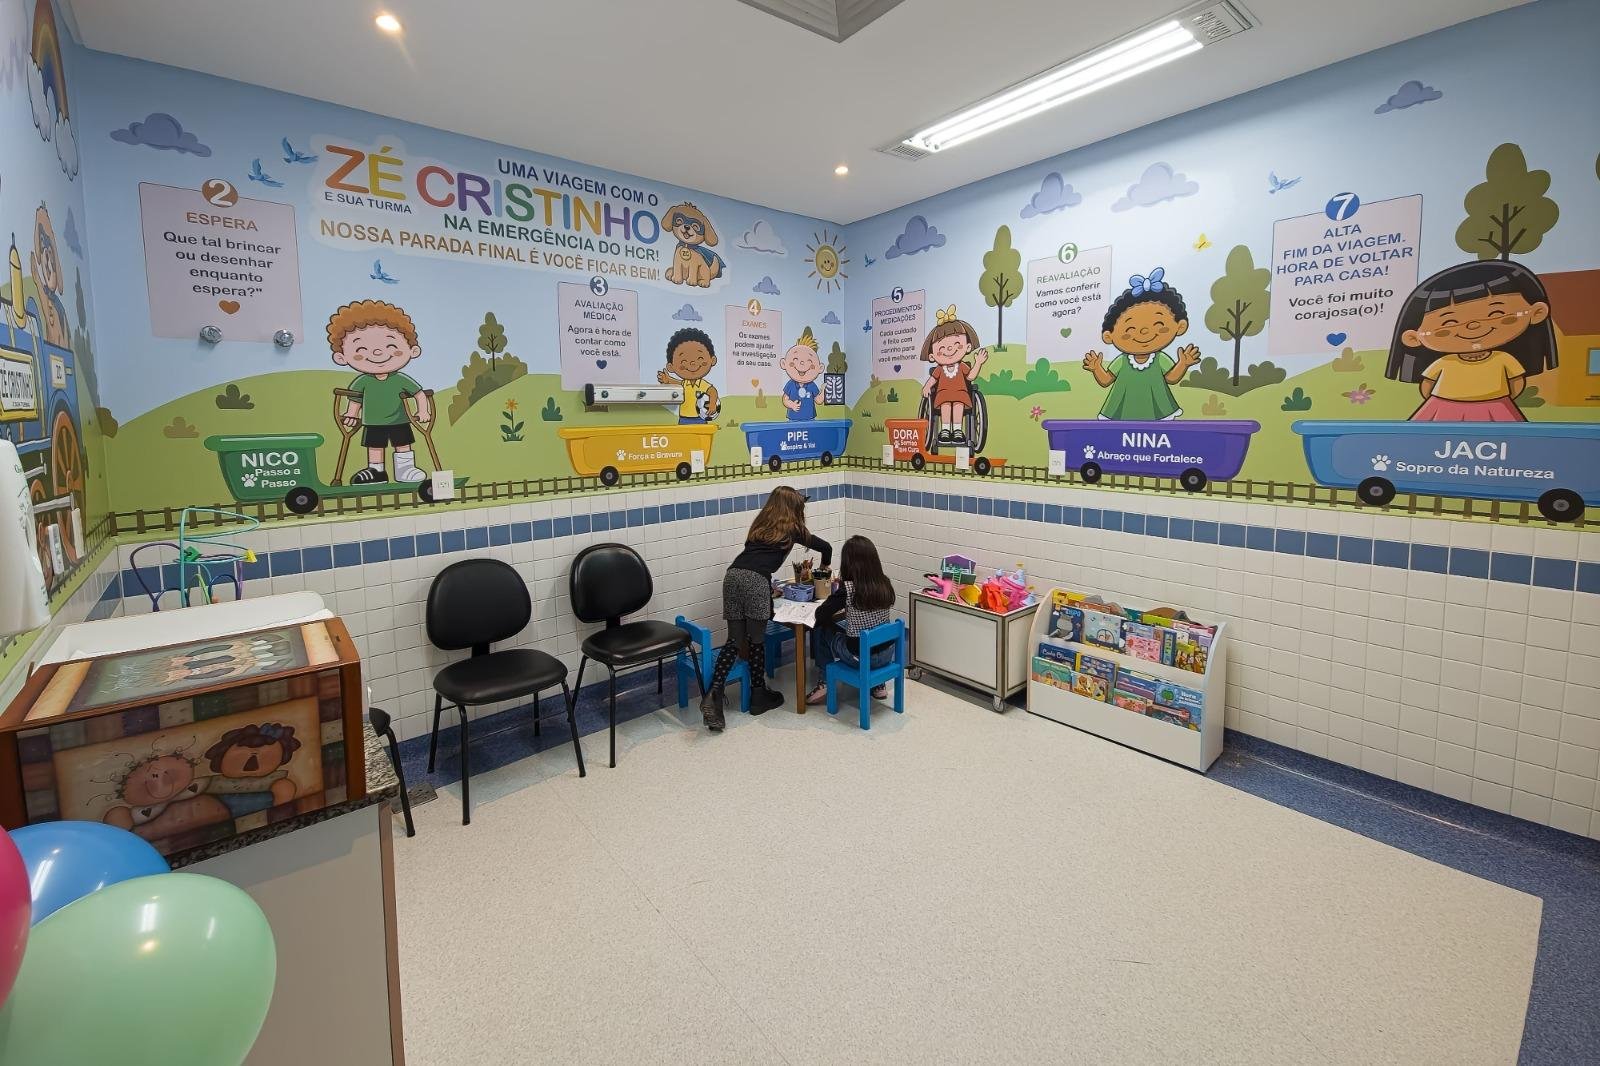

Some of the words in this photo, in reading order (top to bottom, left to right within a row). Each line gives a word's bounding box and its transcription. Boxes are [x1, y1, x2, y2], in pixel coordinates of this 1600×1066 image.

[498, 158, 539, 182] UMA
[543, 169, 606, 196] VIAGEM
[611, 185, 644, 204] COM
[648, 193, 658, 206] O
[209, 179, 233, 207] 2
[325, 145, 406, 200] ZÉ
[416, 166, 660, 244] CRISTINHO
[325, 192, 333, 201] E
[337, 193, 364, 206] SUA
[367, 198, 412, 214] TURMA
[1333, 193, 1354, 221] 7
[186, 211, 258, 231] ESPERA
[444, 213, 472, 232] NA
[478, 219, 594, 251] EMERGÊNCIA
[599, 240, 621, 255] DO
[625, 244, 659, 262] HCR!
[1324, 224, 1361, 239] ALTA
[164, 232, 198, 244] Que
[202, 236, 221, 247] tal
[226, 238, 281, 254] brincar
[320, 219, 394, 245] NOSSA
[400, 231, 474, 255] PARADA
[478, 243, 526, 263] FINAL
[530, 250, 539, 264] É
[543, 252, 583, 270] VOCÊ
[587, 259, 627, 276] FICAR
[631, 265, 660, 281] BEM!
[1283, 248, 1307, 260] FIM
[1312, 244, 1332, 255] DA
[1337, 232, 1406, 251] VIAGEM.
[175, 251, 195, 260] ou
[201, 252, 273, 268] desenhar
[1277, 260, 1318, 275] HORA
[1323, 257, 1344, 268] DE
[1349, 247, 1413, 265] VOLTAR
[190, 268, 263, 282] enquanto
[1036, 266, 1101, 284] REAVALIAÇÃO
[1294, 273, 1334, 286] PARA
[1339, 265, 1389, 281] CASA!
[593, 276, 606, 296] 3
[1036, 288, 1063, 298] Vamos
[1066, 282, 1100, 293] conferir
[574, 299, 624, 312] AVALIAÇÃO
[1035, 299, 1057, 309] como
[1059, 294, 1079, 304] você
[1082, 292, 1101, 302] está
[1289, 294, 1323, 308] Você
[1328, 292, 1346, 303] foi
[1350, 288, 1393, 301] muito
[583, 310, 617, 321] MÉDICA
[1052, 306, 1082, 318] agora?
[1294, 303, 1384, 321] corajosa(o)!
[567, 325, 593, 335] Agora
[602, 327, 620, 336] hora
[622, 329, 632, 337] de
[739, 331, 748, 339] Os
[880, 329, 894, 337] Cada
[895, 327, 917, 335] cuidado
[575, 337, 602, 345] contar
[604, 339, 626, 347] como
[734, 341, 755, 349] podem
[756, 342, 774, 350] ajudar
[887, 337, 900, 345] feito
[580, 348, 600, 356] você
[881, 346, 901, 354] carinho
[902, 345, 915, 353] para
[878, 355, 891, 363] você
[642, 434, 669, 449] LÉO
[787, 431, 808, 441] PIPE
[893, 428, 919, 440] DORA
[1122, 432, 1171, 448] NINA
[628, 453, 649, 461] Força
[656, 451, 683, 459] Bravura
[1097, 450, 1131, 462] Abraço
[1133, 453, 1151, 463] que
[1154, 453, 1203, 464] Fortalece
[1434, 440, 1507, 461] JACI
[241, 451, 299, 467] NICO
[255, 467, 290, 477] Passo
[1396, 461, 1443, 475] Sopro
[1448, 463, 1469, 475] da
[1474, 465, 1555, 479] Natureza
[261, 479, 297, 488] Passo
